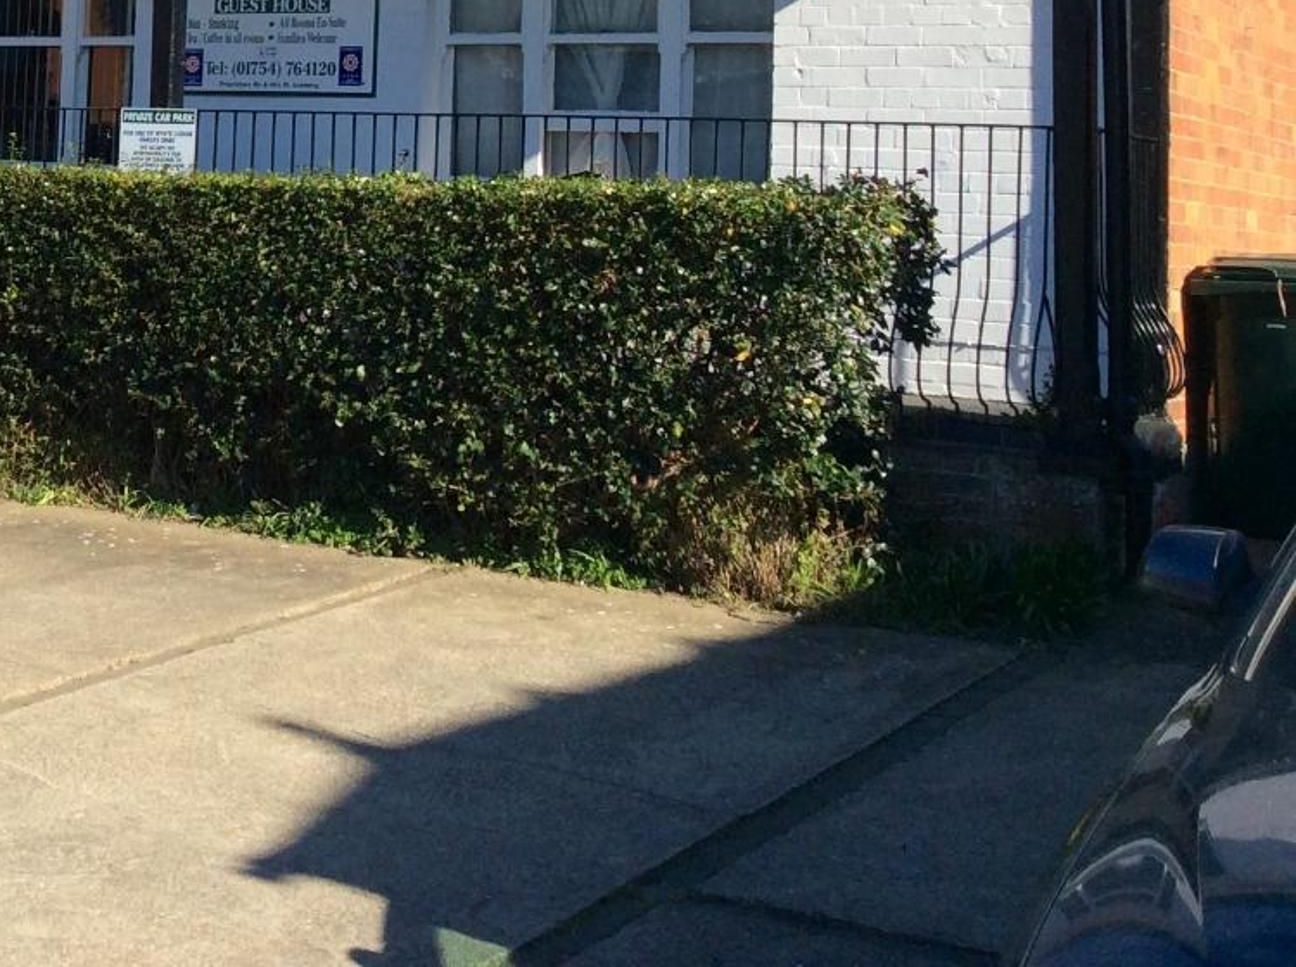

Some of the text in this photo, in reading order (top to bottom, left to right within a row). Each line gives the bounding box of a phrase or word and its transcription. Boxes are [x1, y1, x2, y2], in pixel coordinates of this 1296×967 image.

[207, 61, 336, 77] Tel: (01754) 764120
[124, 111, 193, 122] PRIVATE CAR PARK
